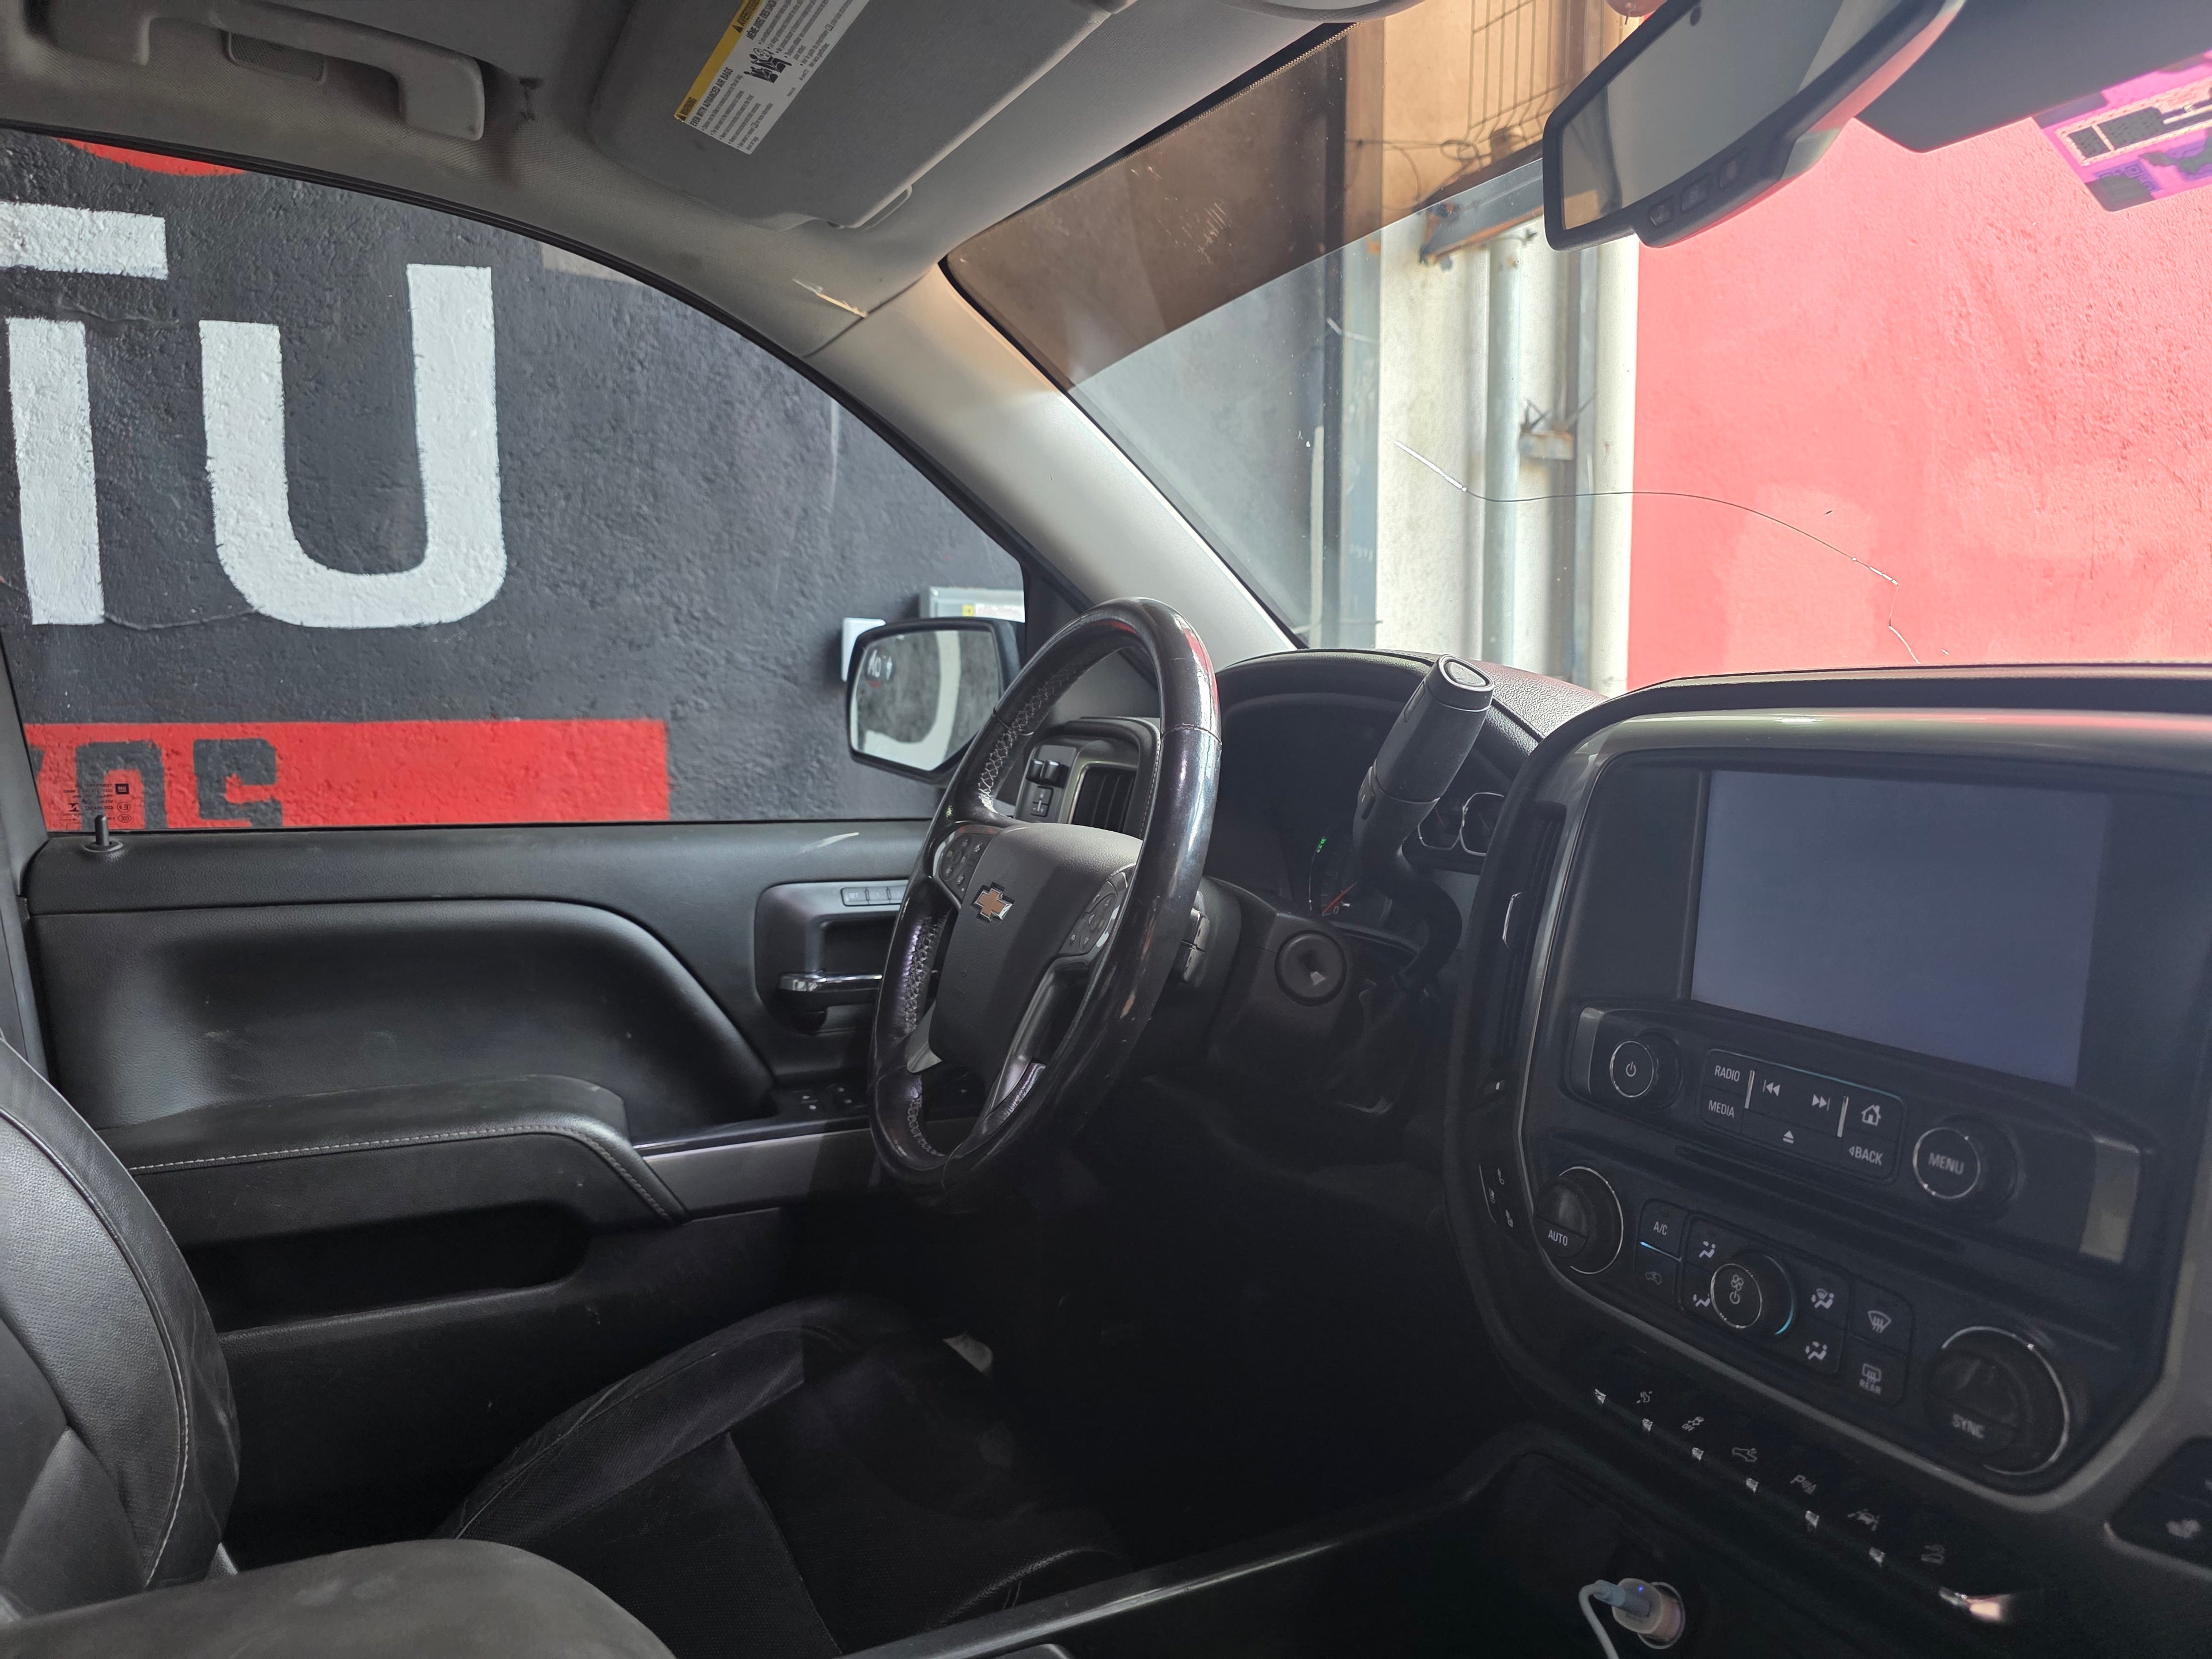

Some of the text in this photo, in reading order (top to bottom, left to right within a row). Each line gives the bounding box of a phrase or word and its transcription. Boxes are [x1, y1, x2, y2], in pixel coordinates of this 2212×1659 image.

[690, 66, 733, 127] EVEN WITH ADVANCED AIR BAGS
[680, 97, 698, 116] WARNING
[1714, 1065, 1740, 1082] RADIO
[1708, 1100, 1735, 1119] MEDIA
[1853, 1146, 1883, 1166] BACK
[1929, 1152, 1964, 1175] MENU
[1548, 1229, 1568, 1247] AUTO
[1653, 1221, 1668, 1236] A/C
[1859, 1378, 1882, 1395] REAR
[1681, 1423, 1695, 1432] OFF
[1952, 1414, 1985, 1440] SYNC
